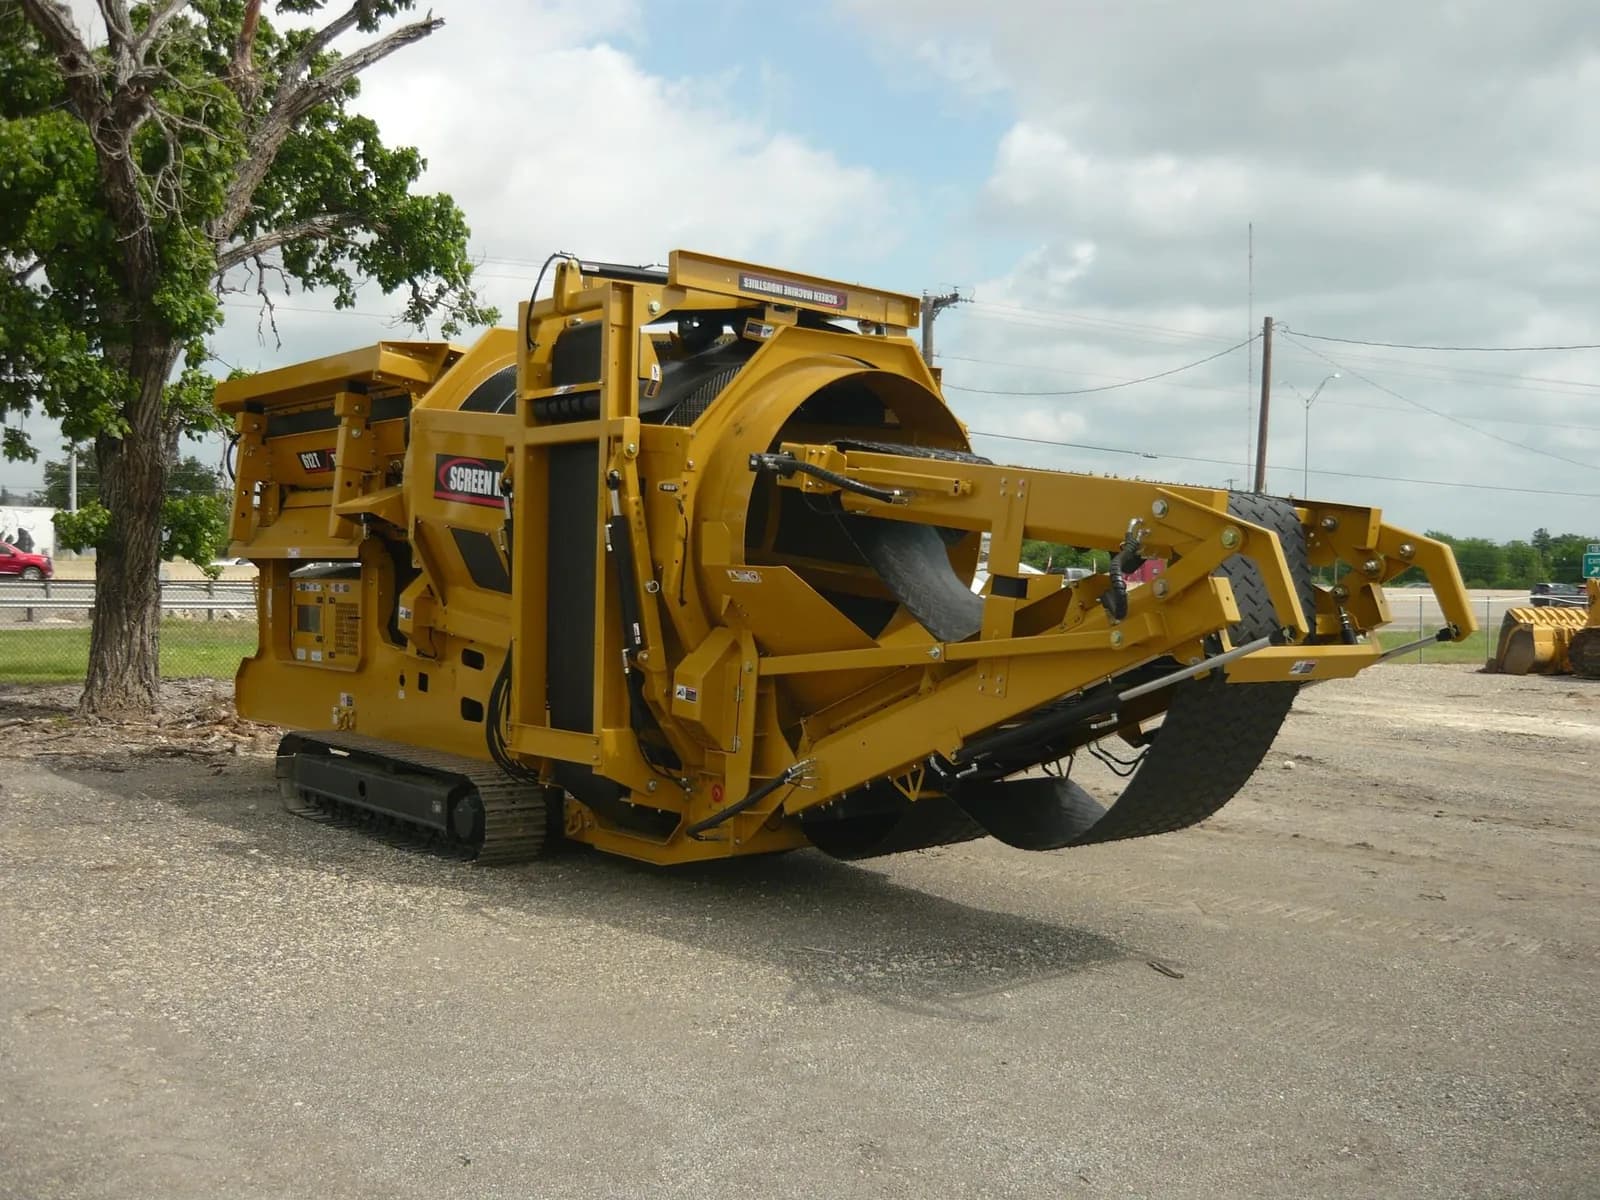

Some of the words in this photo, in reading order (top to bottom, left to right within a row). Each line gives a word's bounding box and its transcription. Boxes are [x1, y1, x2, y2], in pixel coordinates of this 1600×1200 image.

[743, 277, 783, 295] INDUSTRIES
[784, 285, 813, 300] MACHINE
[813, 290, 838, 305] SCREEN
[449, 465, 493, 496] SCREEN
